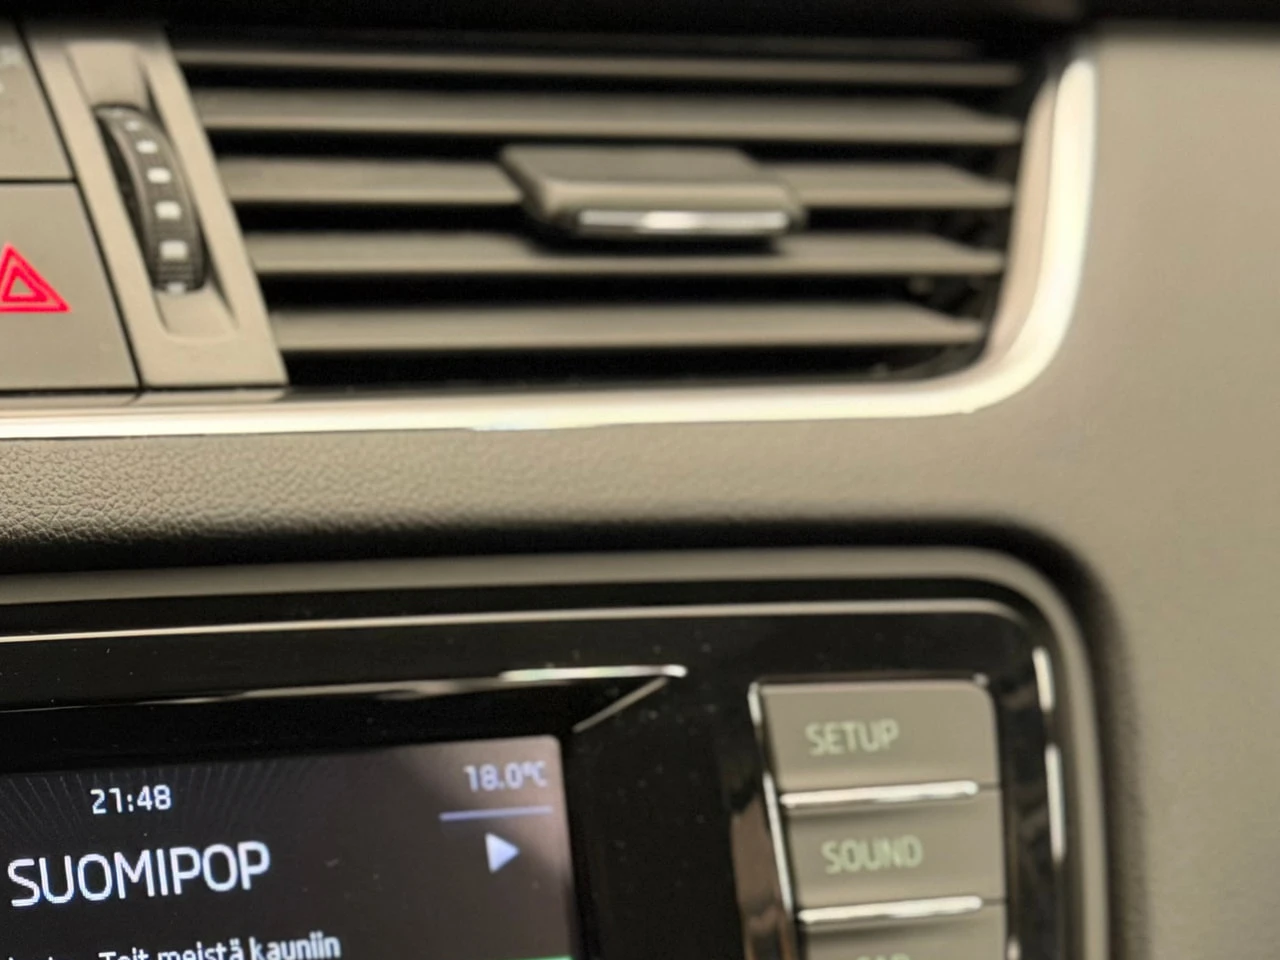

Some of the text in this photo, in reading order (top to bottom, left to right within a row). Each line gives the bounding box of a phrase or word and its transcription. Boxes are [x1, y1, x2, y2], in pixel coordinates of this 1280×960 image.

[805, 718, 900, 755] SETUP
[90, 784, 172, 815] 21:48
[822, 835, 924, 873] SOUND
[7, 840, 271, 908] SUOMIPOP
